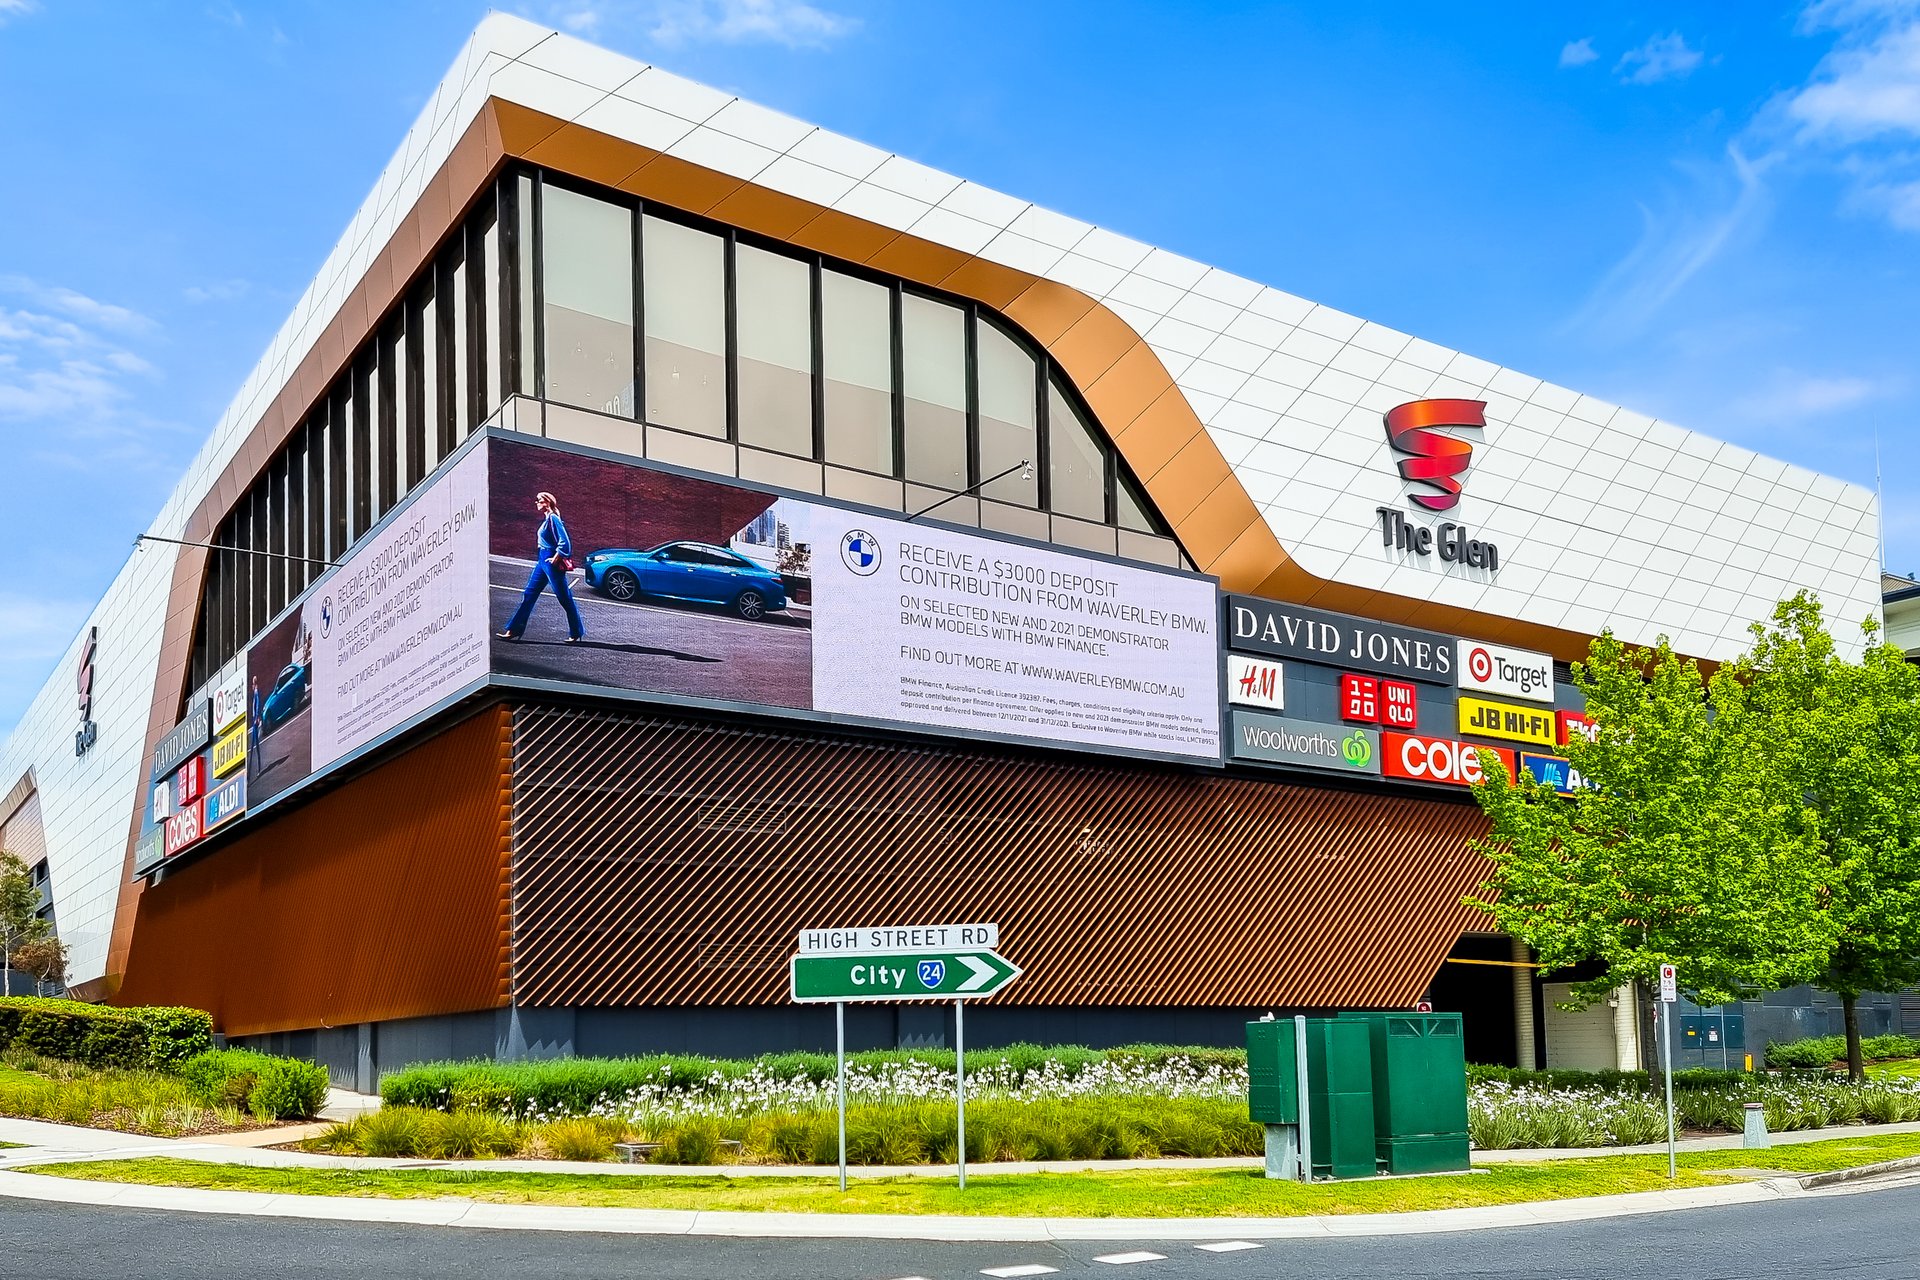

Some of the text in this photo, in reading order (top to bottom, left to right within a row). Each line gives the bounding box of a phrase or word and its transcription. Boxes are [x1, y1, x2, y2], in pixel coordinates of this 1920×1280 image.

[1376, 506, 1498, 571] The Glen
[337, 498, 478, 626] CONTRIBUTION FROM WAVERLEY BMW.
[338, 569, 364, 605] RECEIVE
[365, 566, 370, 581] A
[394, 515, 426, 558] DEPOSIT
[900, 542, 1118, 598] RECEIVE A $3000 DEPOSIT
[381, 599, 393, 618] AND
[406, 551, 454, 600] DEMONSTRATOR
[900, 564, 1209, 634] CONTRIBUTION FROM WAVERLEY BMW.
[900, 594, 1169, 651] ON SELECTED NEW AND 2021 DEMONSTRATOR
[900, 611, 1109, 657] BMW MODELS WITH BMW FINANCE.
[1235, 606, 1451, 674] DAVID JONES
[900, 645, 1185, 698] FIND OUT MORE AT WWW.WAVERLEYBMW.COM.AU
[1239, 664, 1276, 701] H&M
[1494, 656, 1548, 694] Target
[224, 678, 244, 714] Target
[900, 676, 916, 685] BMW
[945, 683, 976, 694] Australian
[977, 687, 995, 696] Credit
[996, 690, 1017, 699] Licence
[1083, 702, 1110, 712] conditions
[900, 701, 930, 710] approved
[900, 689, 924, 698] deposit
[925, 693, 960, 703] contribution
[1044, 708, 1064, 717] applies
[1110, 716, 1145, 726] demonstrator
[1145, 720, 1159, 728] BMW
[1388, 686, 1411, 704] UNI
[1388, 704, 1414, 724] QLO
[1470, 707, 1501, 730] JB
[155, 709, 207, 774] DAVID JONES
[214, 744, 226, 771] JB
[1242, 725, 1338, 758] Woolworths
[1401, 738, 1502, 783] cole
[218, 782, 239, 817] ALDI
[169, 805, 197, 851] coles
[808, 928, 989, 950] HIGH STREET RD
[850, 964, 941, 989] City 24
